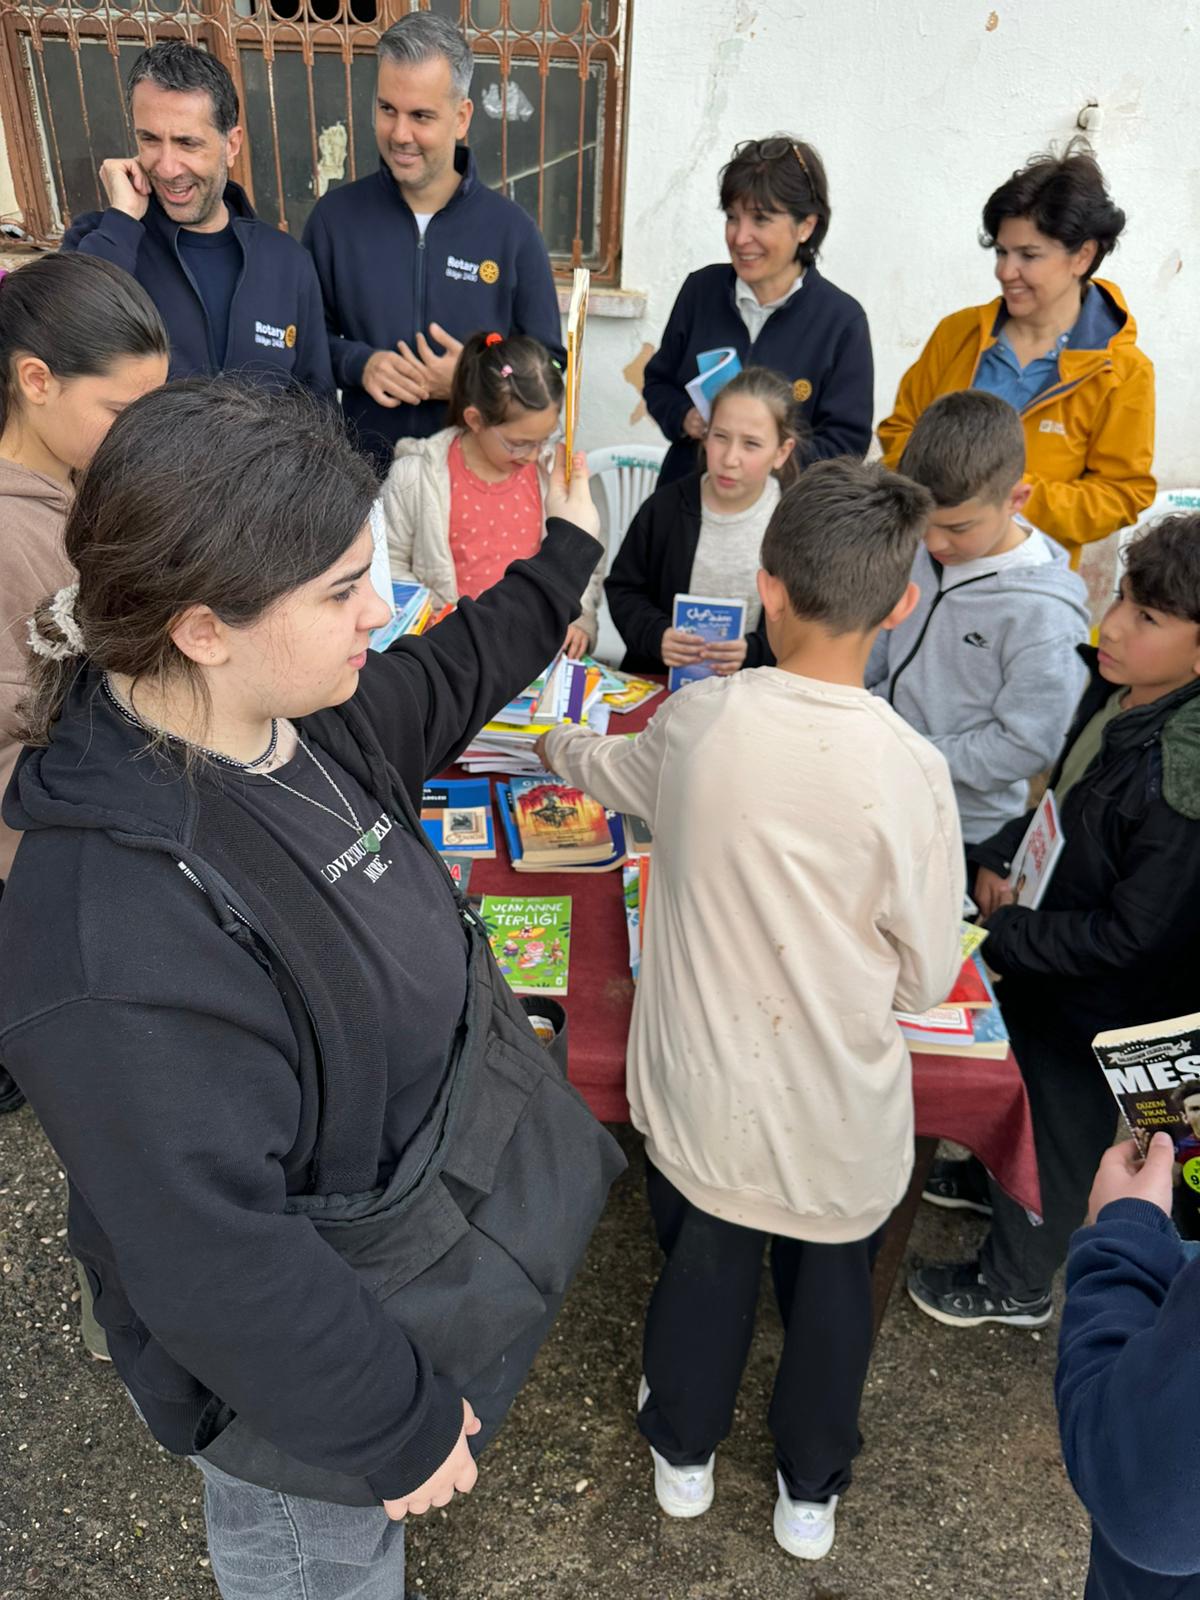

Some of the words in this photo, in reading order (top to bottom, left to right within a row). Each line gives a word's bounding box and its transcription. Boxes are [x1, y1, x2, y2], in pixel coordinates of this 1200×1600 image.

[447, 255, 480, 275] Rotary
[255, 320, 286, 340] Rotary
[491, 903, 523, 913] UÇAN
[525, 902, 564, 912] ANNE
[495, 911, 558, 926] TERLİĞİ
[1137, 1114, 1180, 1126] FUTBOLCU
